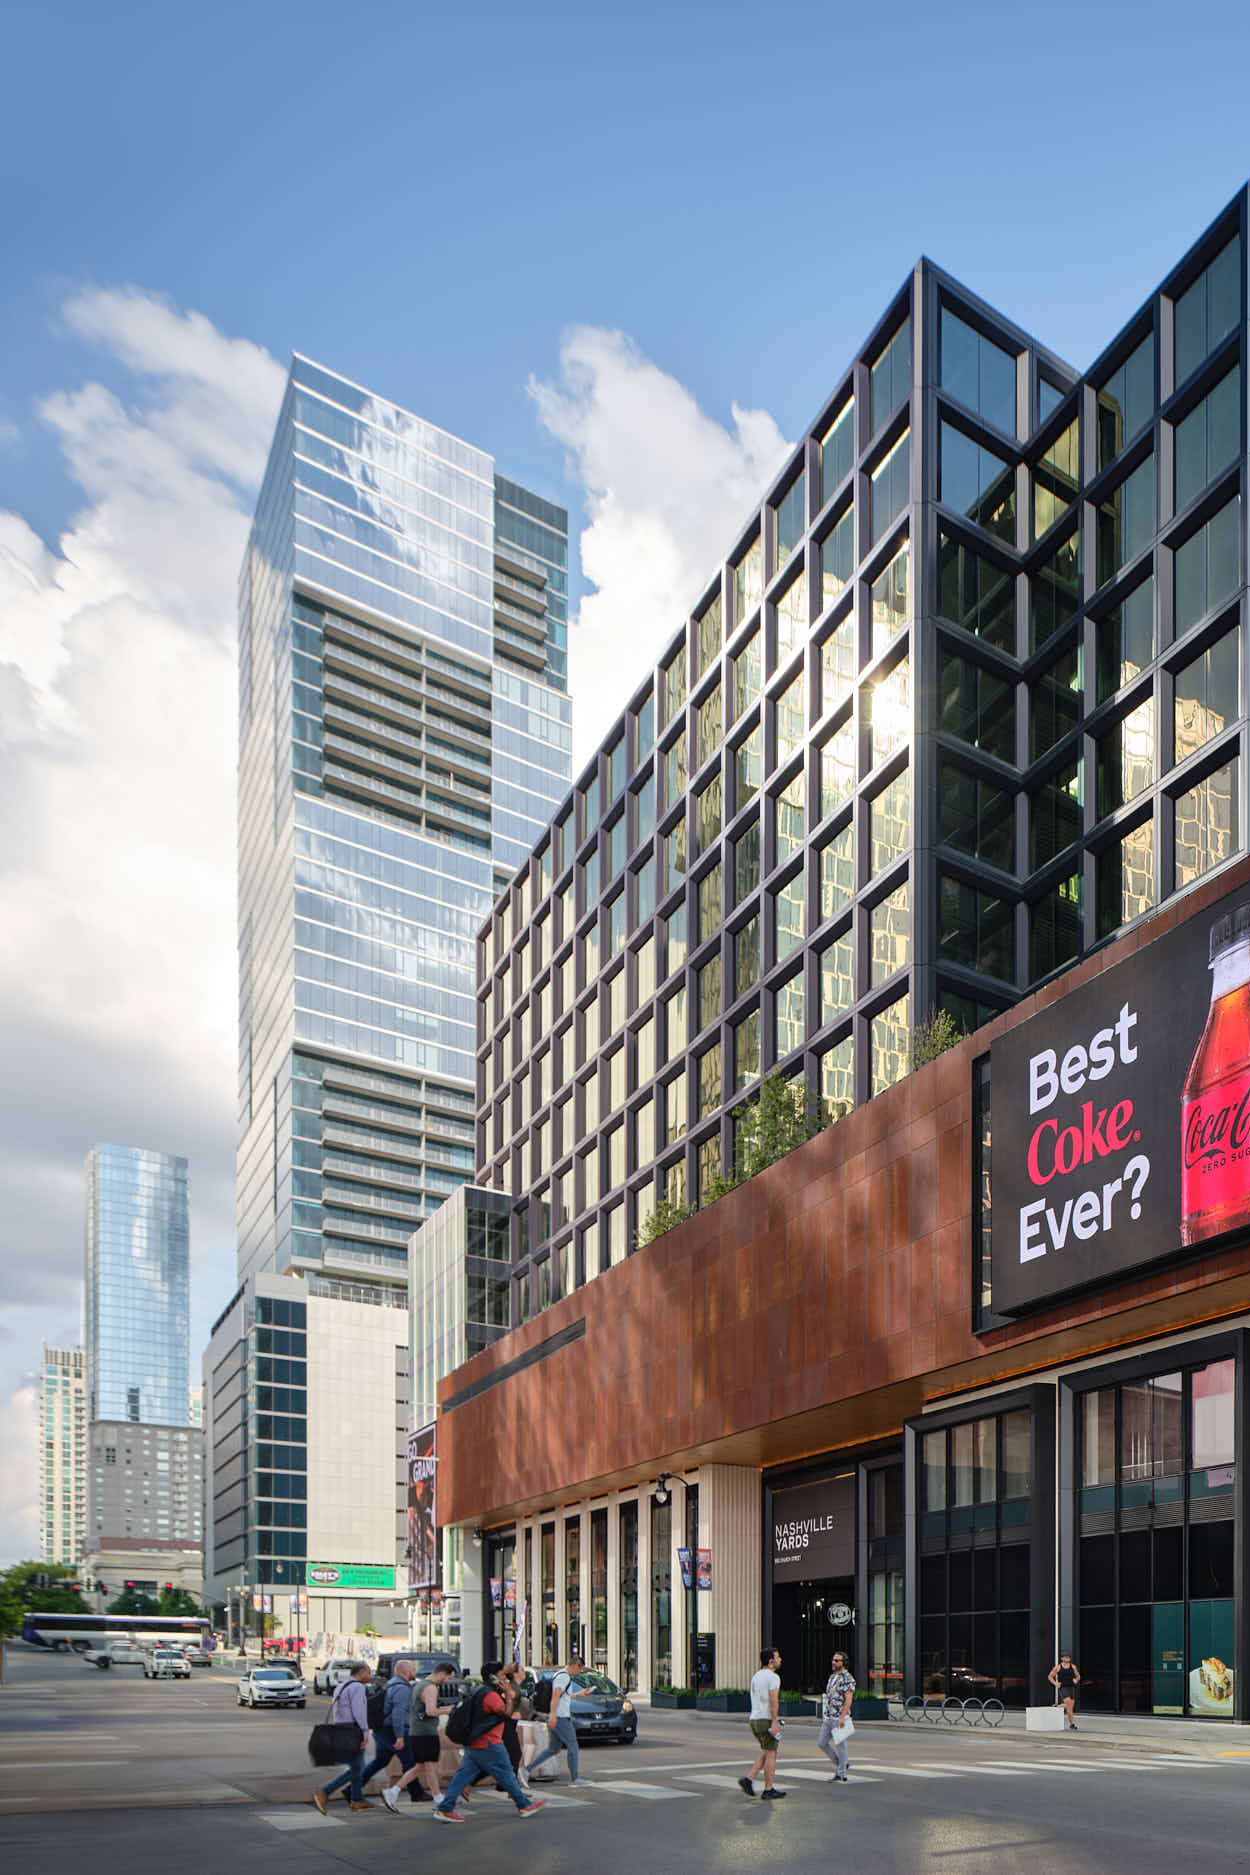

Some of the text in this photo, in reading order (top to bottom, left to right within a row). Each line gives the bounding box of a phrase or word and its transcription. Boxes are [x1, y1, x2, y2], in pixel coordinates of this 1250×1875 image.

[1029, 1001, 1138, 1115] Best
[1202, 1157, 1226, 1174] ZERO
[1020, 1154, 1150, 1264] Ever?
[775, 1515, 833, 1538] NASHVILLE
[775, 1534, 809, 1551] YARDS
